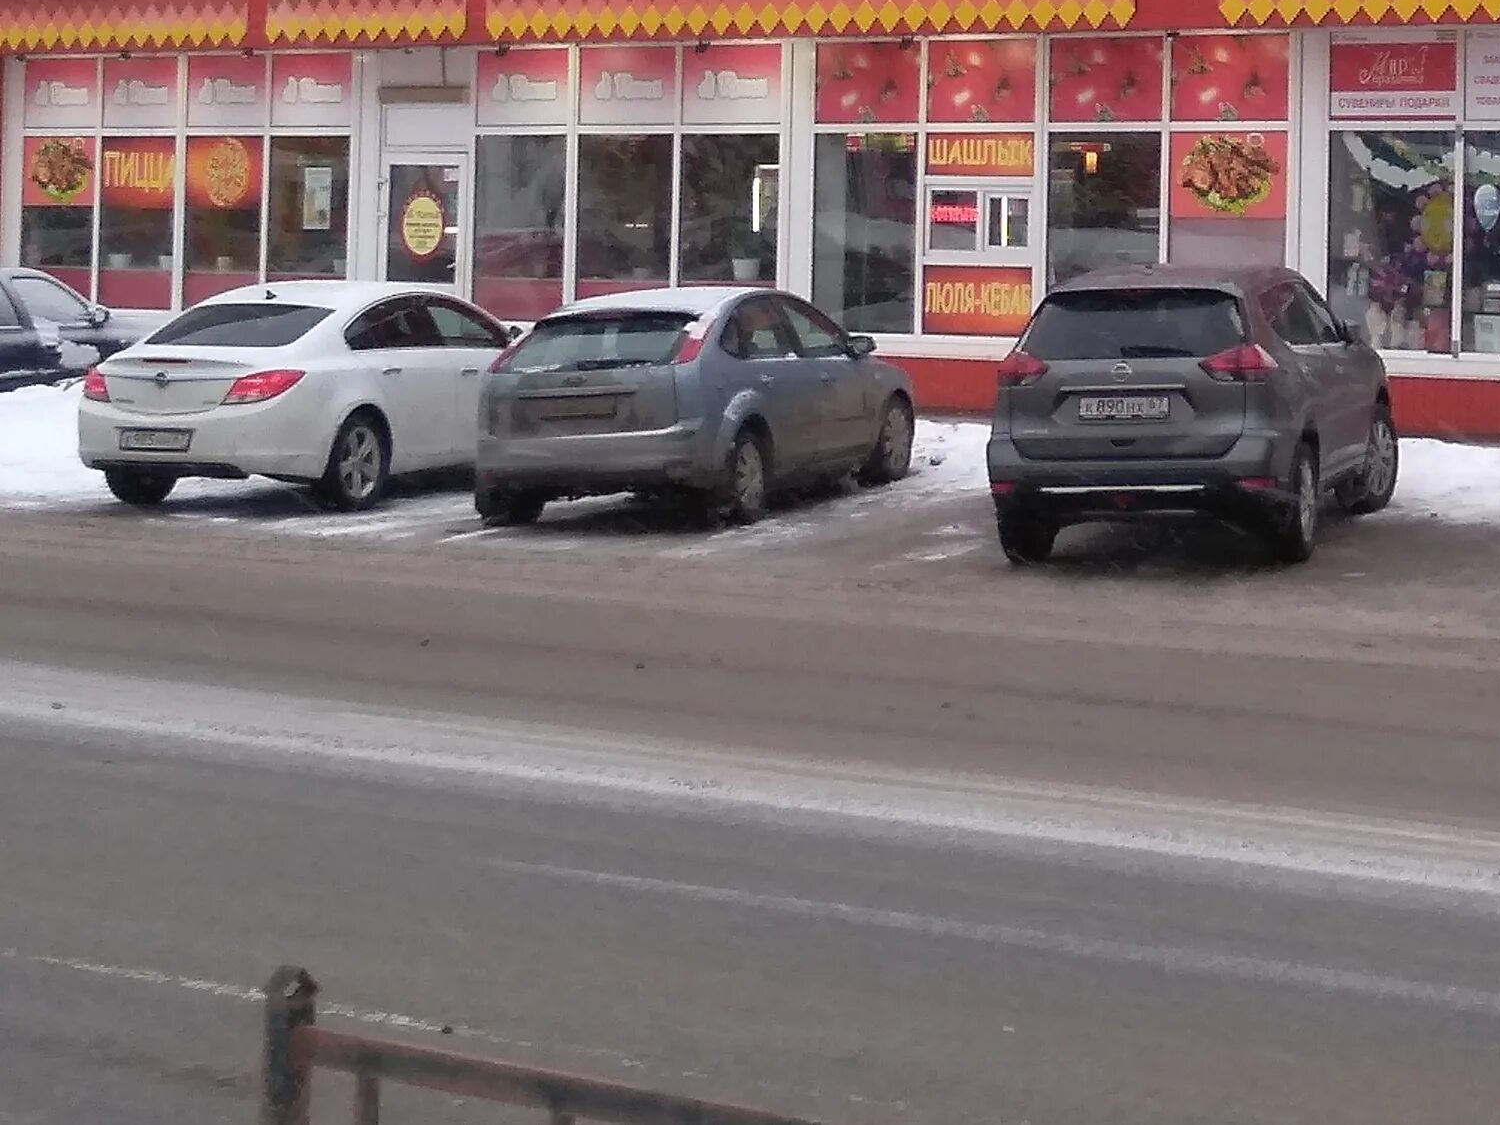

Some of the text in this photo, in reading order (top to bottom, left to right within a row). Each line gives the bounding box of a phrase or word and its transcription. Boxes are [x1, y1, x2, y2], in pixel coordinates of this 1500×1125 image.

[1338, 97, 1449, 109] СУВЕНИРЫ ПОДАРКИ
[929, 138, 1033, 166] ШАШЛЫК
